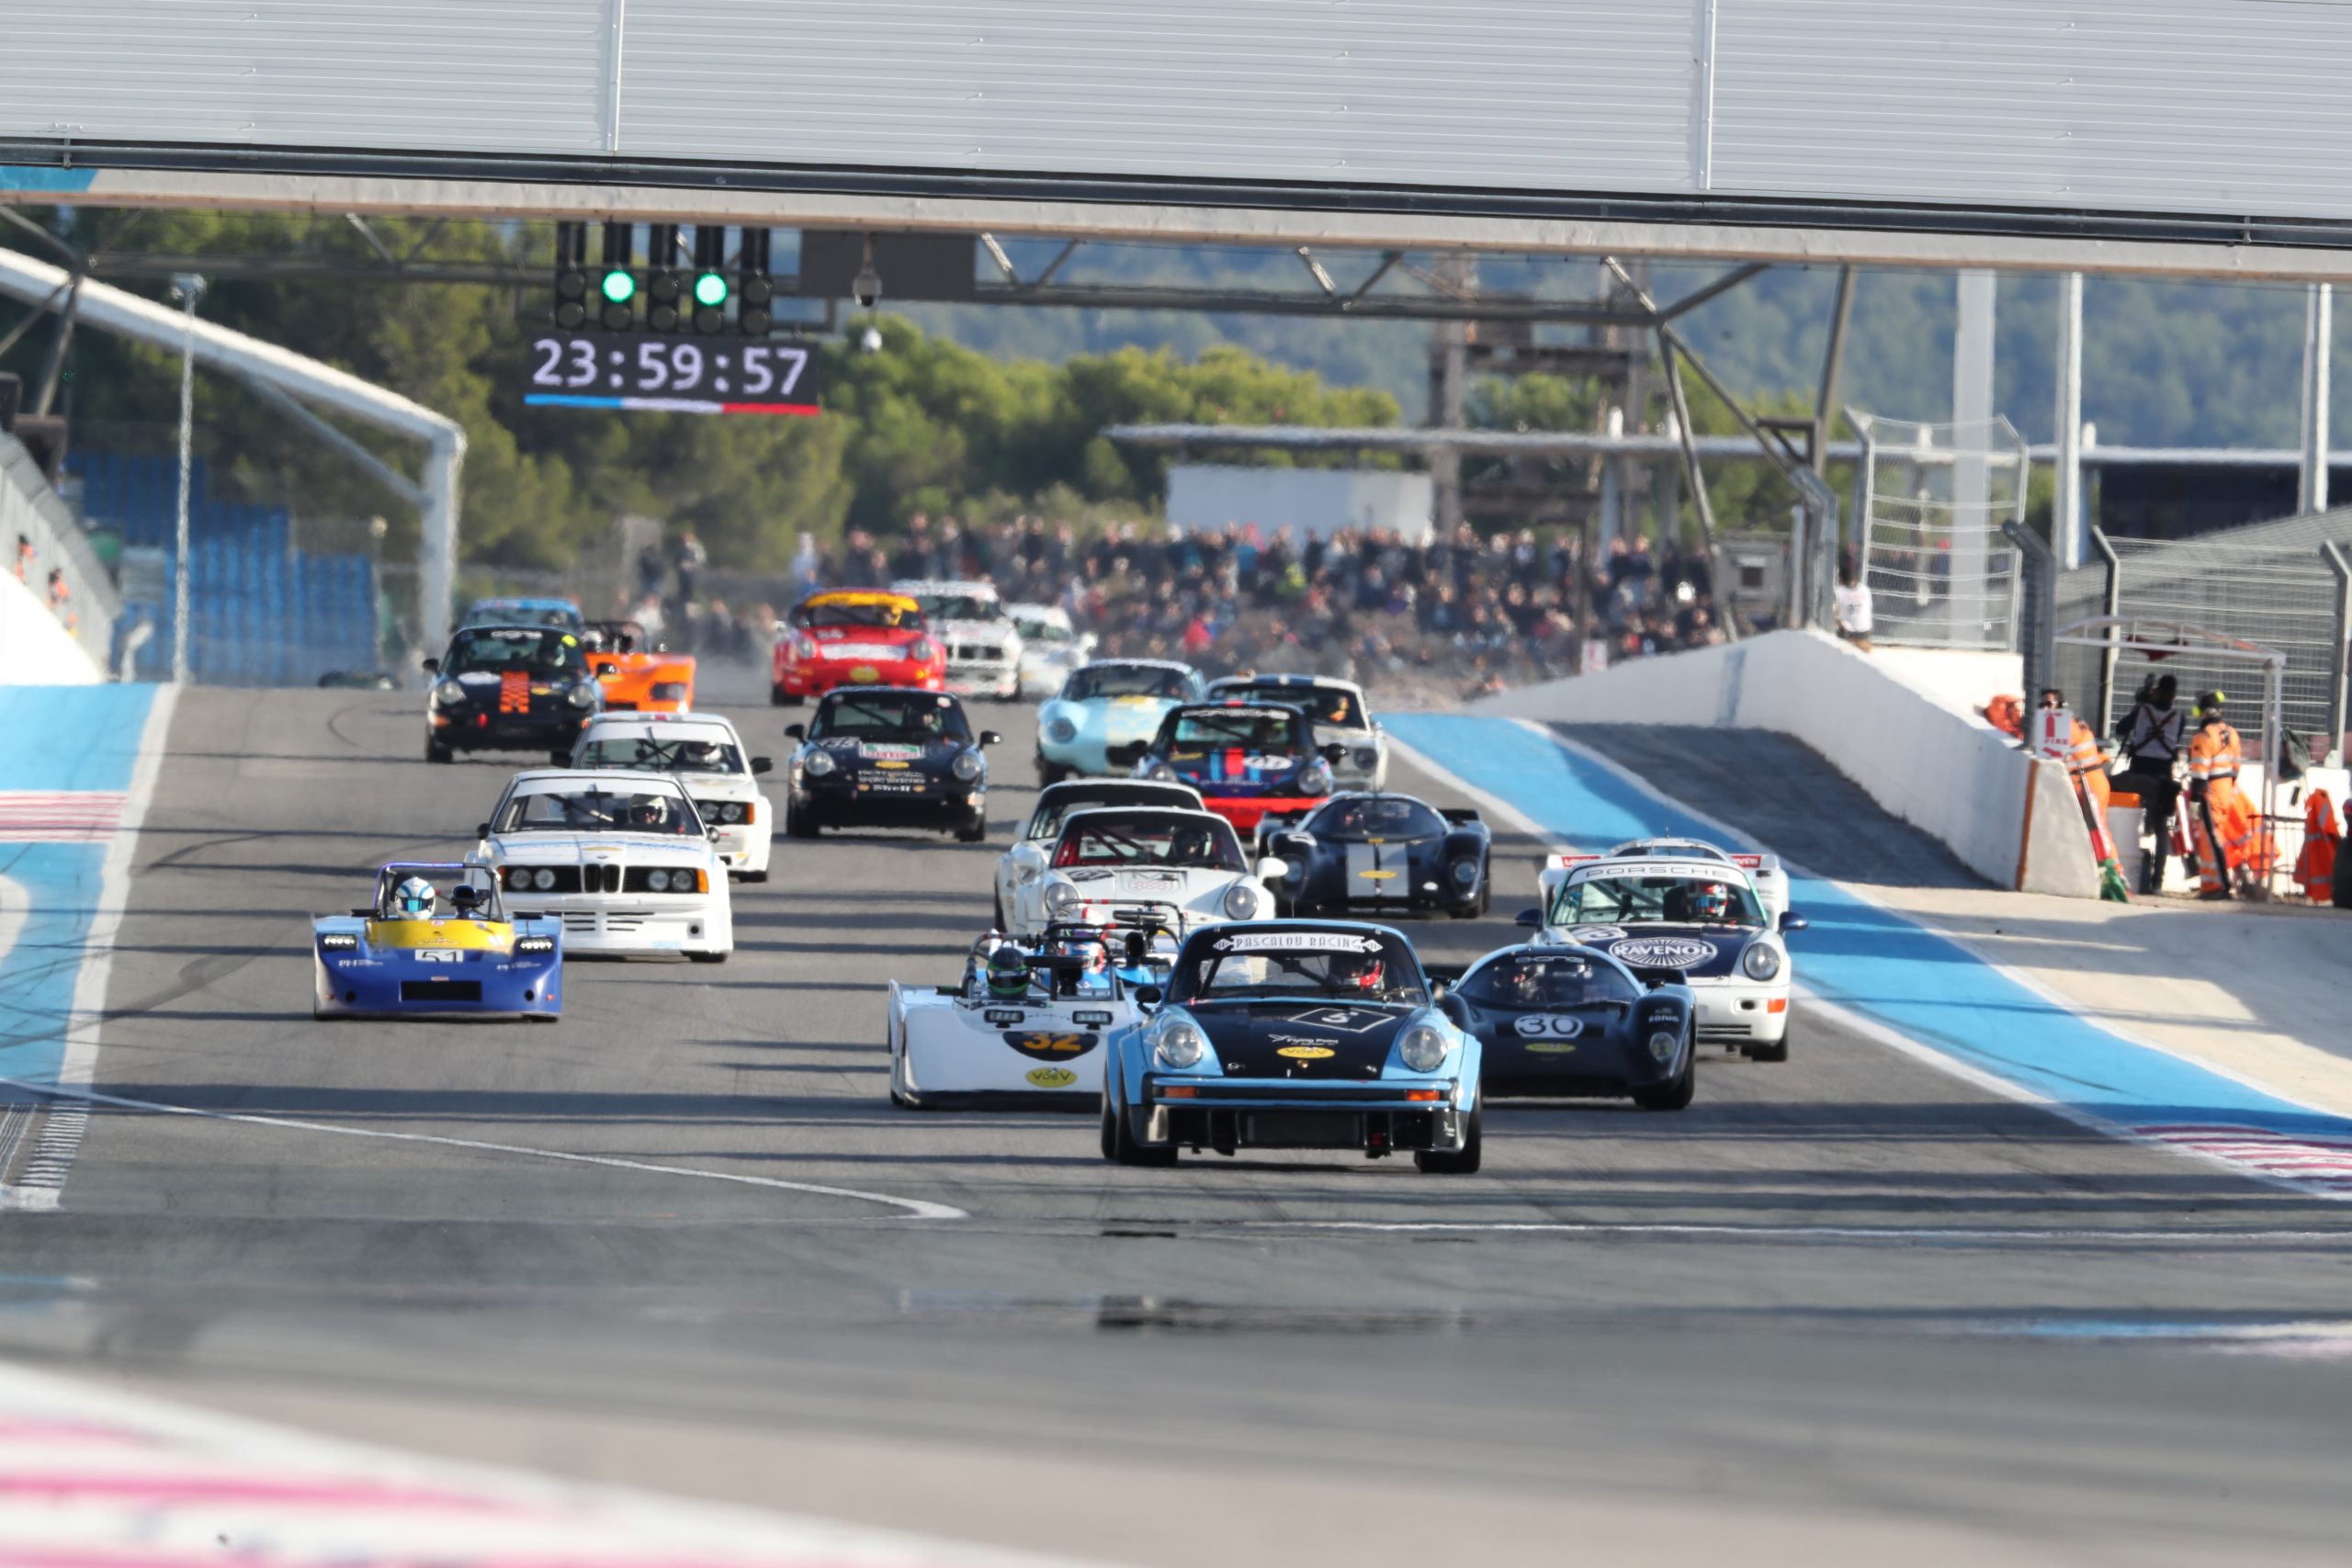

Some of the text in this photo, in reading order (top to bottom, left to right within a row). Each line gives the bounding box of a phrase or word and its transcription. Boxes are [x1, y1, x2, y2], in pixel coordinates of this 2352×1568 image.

[533, 338, 808, 396] 23:59:57
[1587, 866, 1730, 878] PORSCHE
[1236, 936, 1363, 949] PASCALOU RACING
[1614, 945, 1713, 955] RAVENOL
[1519, 1018, 1579, 1035] 30
[1023, 1032, 1081, 1051] 32
